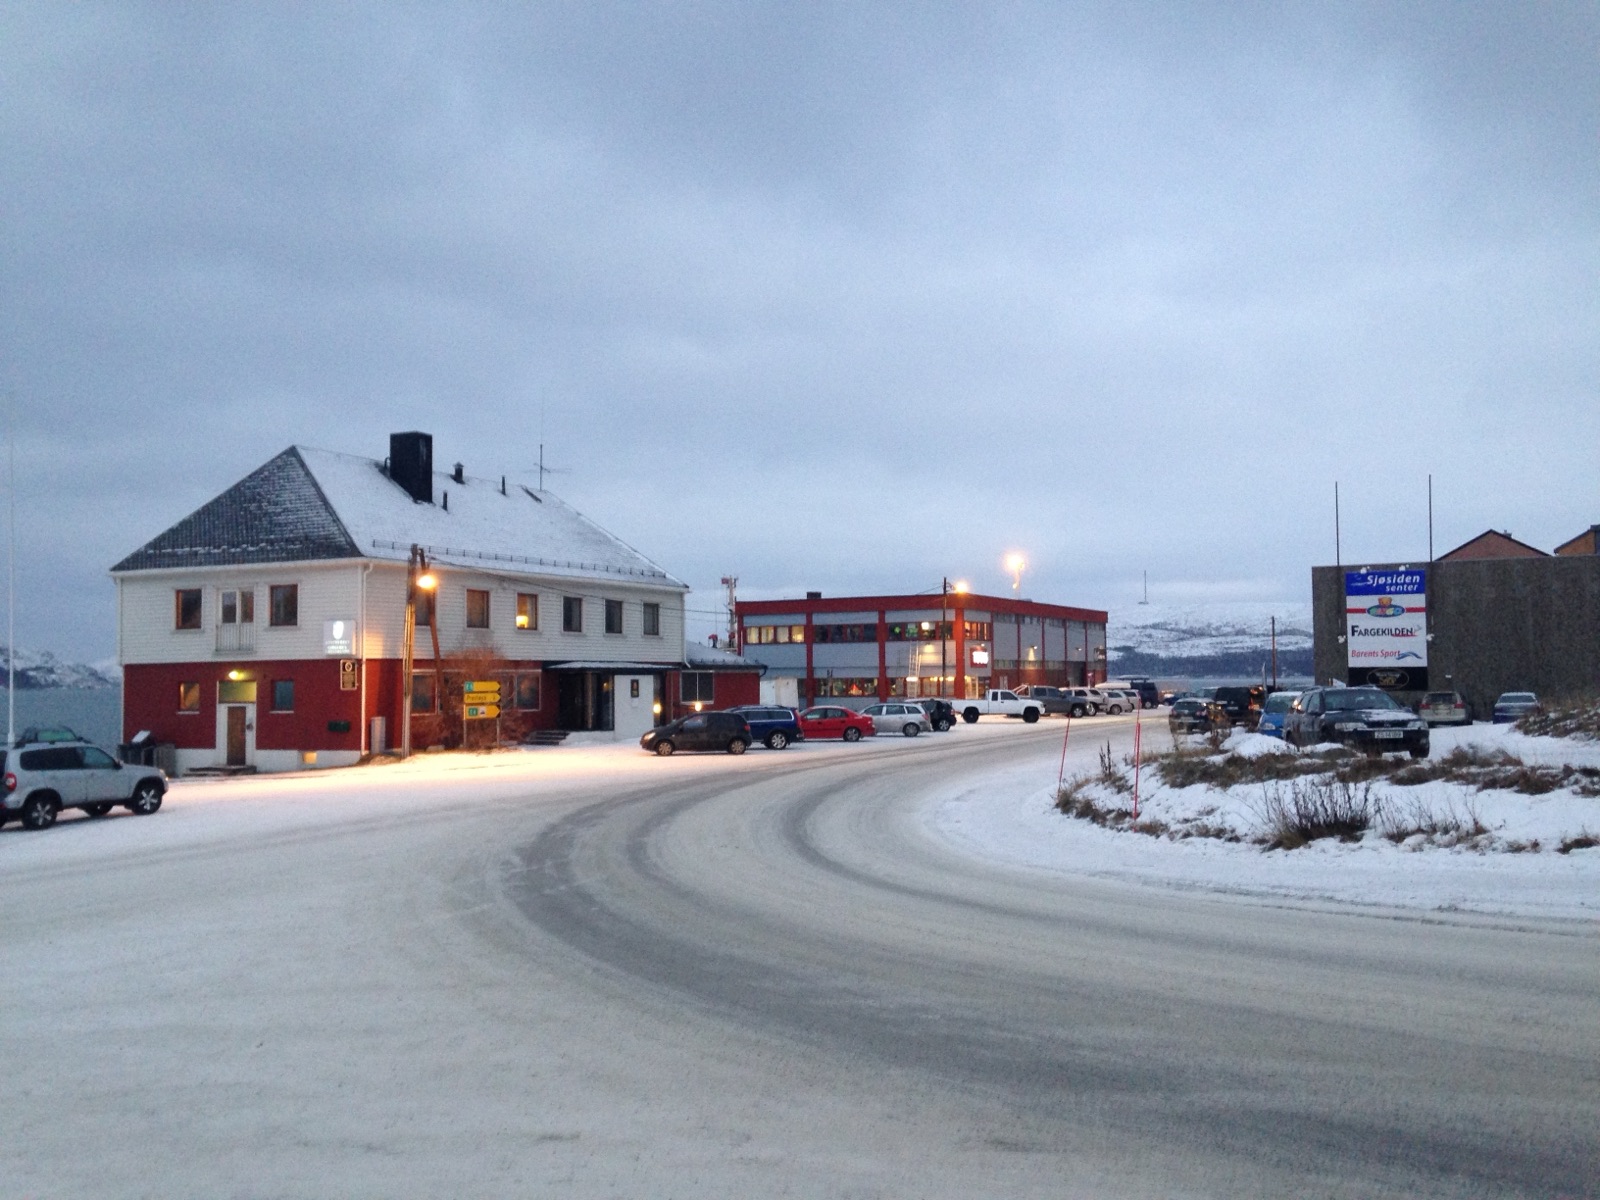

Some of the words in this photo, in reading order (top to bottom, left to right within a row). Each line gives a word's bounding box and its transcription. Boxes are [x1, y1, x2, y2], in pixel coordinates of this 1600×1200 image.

[1366, 574, 1420, 587] Sjøsiden
[1385, 584, 1418, 592] senter
[1351, 625, 1413, 637] FARGEKILDEN
[1351, 650, 1379, 658] Barents
[1380, 649, 1401, 659] Sport
